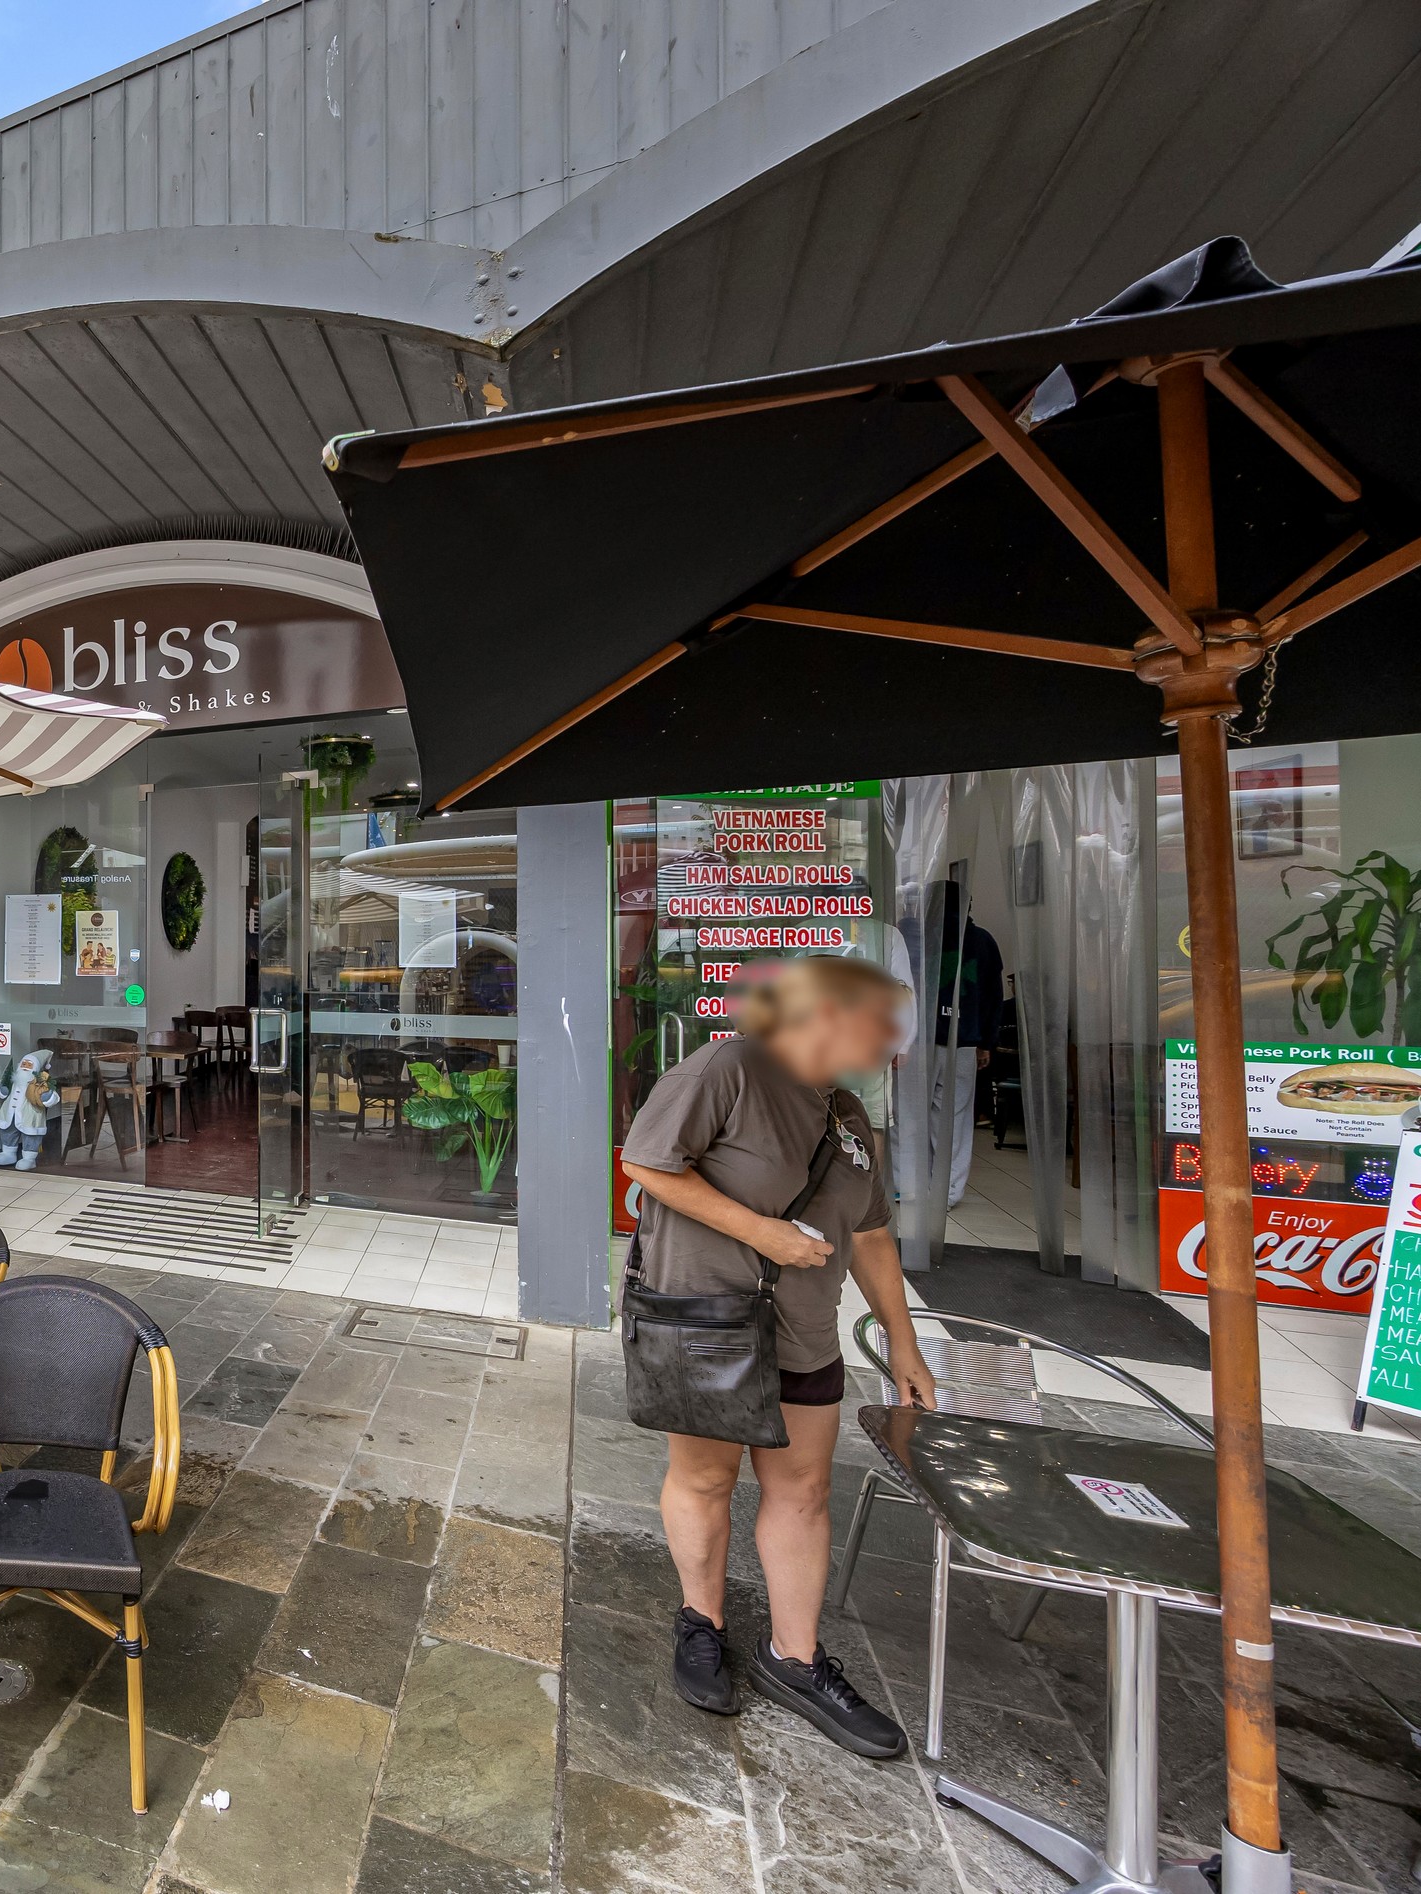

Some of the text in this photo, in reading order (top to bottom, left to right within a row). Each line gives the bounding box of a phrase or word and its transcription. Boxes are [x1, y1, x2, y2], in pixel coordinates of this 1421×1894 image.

[63, 618, 241, 692] bliss
[138, 688, 272, 714] & Shakes
[713, 810, 826, 830] VIETNAMESE
[714, 832, 826, 852] PORK ROLL
[686, 866, 853, 885] HAM SALAD ROLLS
[668, 897, 873, 917] CHICKEN SALAD ROLLS
[697, 928, 843, 947] SAUSAGE ROLLS
[57, 1008, 79, 1017] bliss
[403, 1017, 432, 1028] bliss
[1289, 1047, 1332, 1059] Pork
[1338, 1049, 1374, 1060] Roll
[1248, 1075, 1276, 1084] Belly
[1263, 1126, 1298, 1135] Sauce
[1175, 1143, 1319, 1194] Bery
[1267, 1210, 1333, 1233] Enjoy
[1374, 1368, 1414, 1391] ALL
